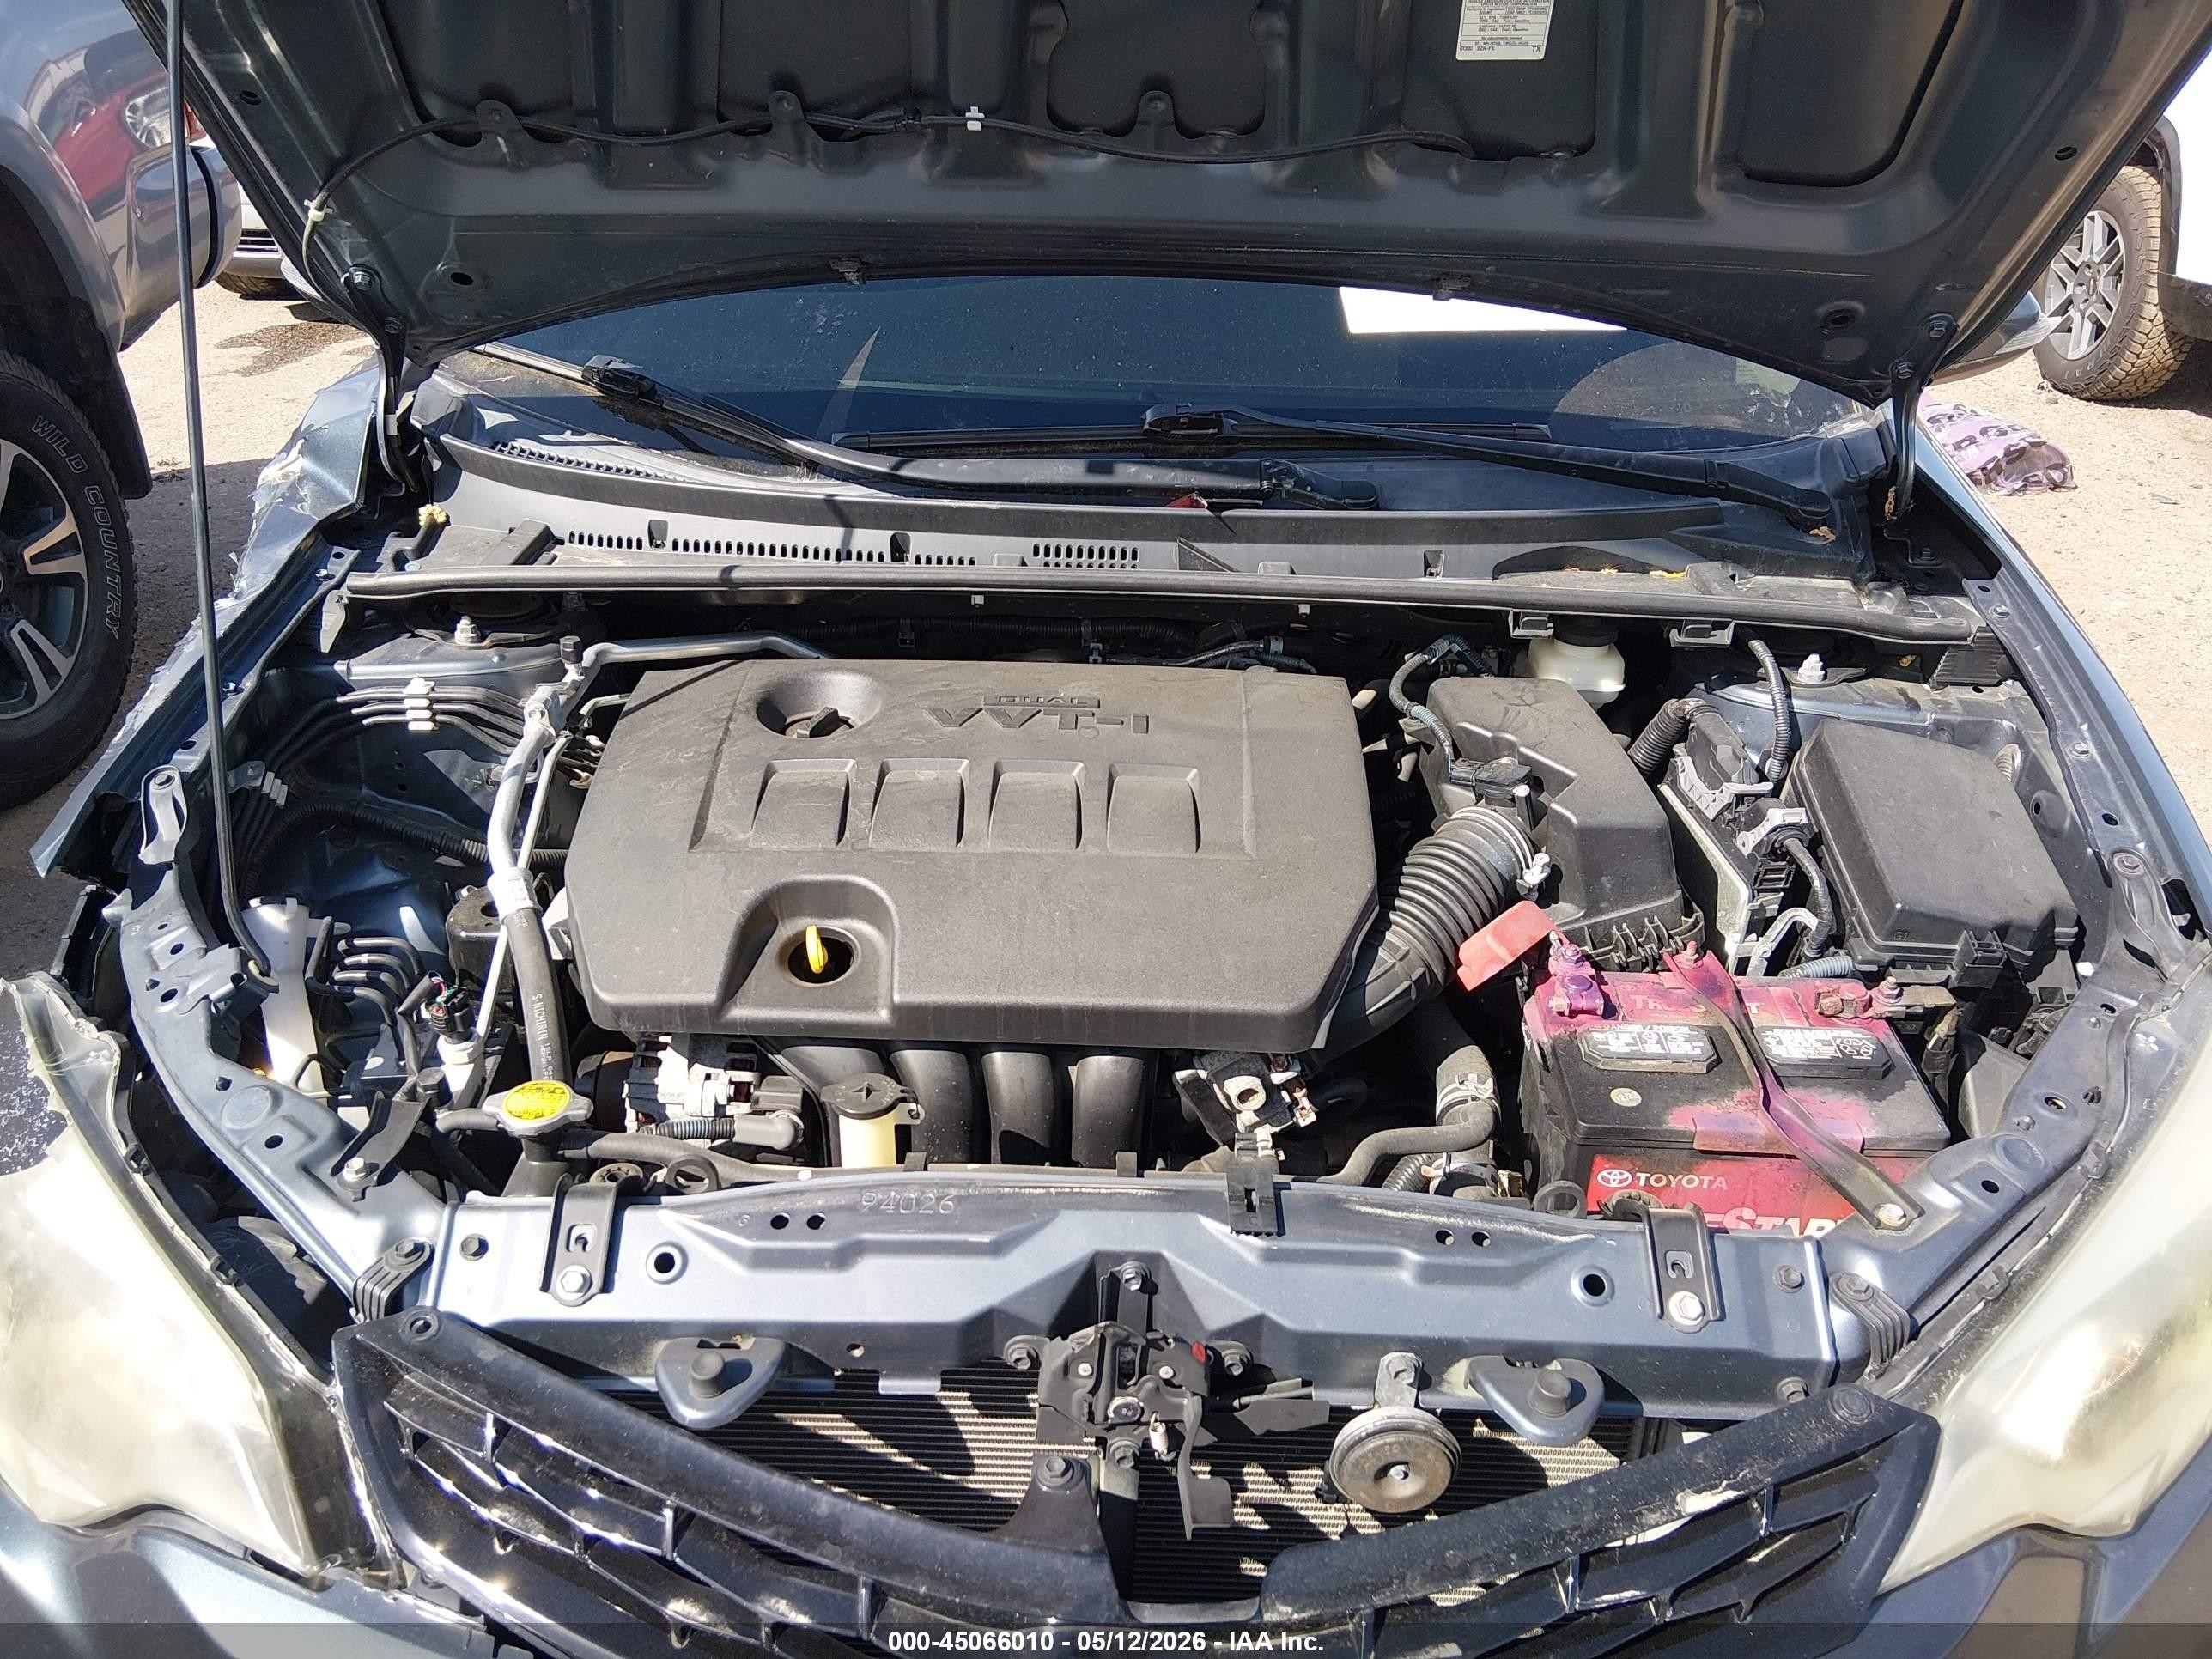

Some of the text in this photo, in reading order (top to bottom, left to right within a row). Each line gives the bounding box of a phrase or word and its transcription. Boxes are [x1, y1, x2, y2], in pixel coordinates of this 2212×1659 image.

[30, 415, 124, 640] WILD COUNTRY
[998, 695, 1089, 705] DUAL
[1635, 1171, 1729, 1190] TOYOTA
[861, 1191, 955, 1214] 94026
